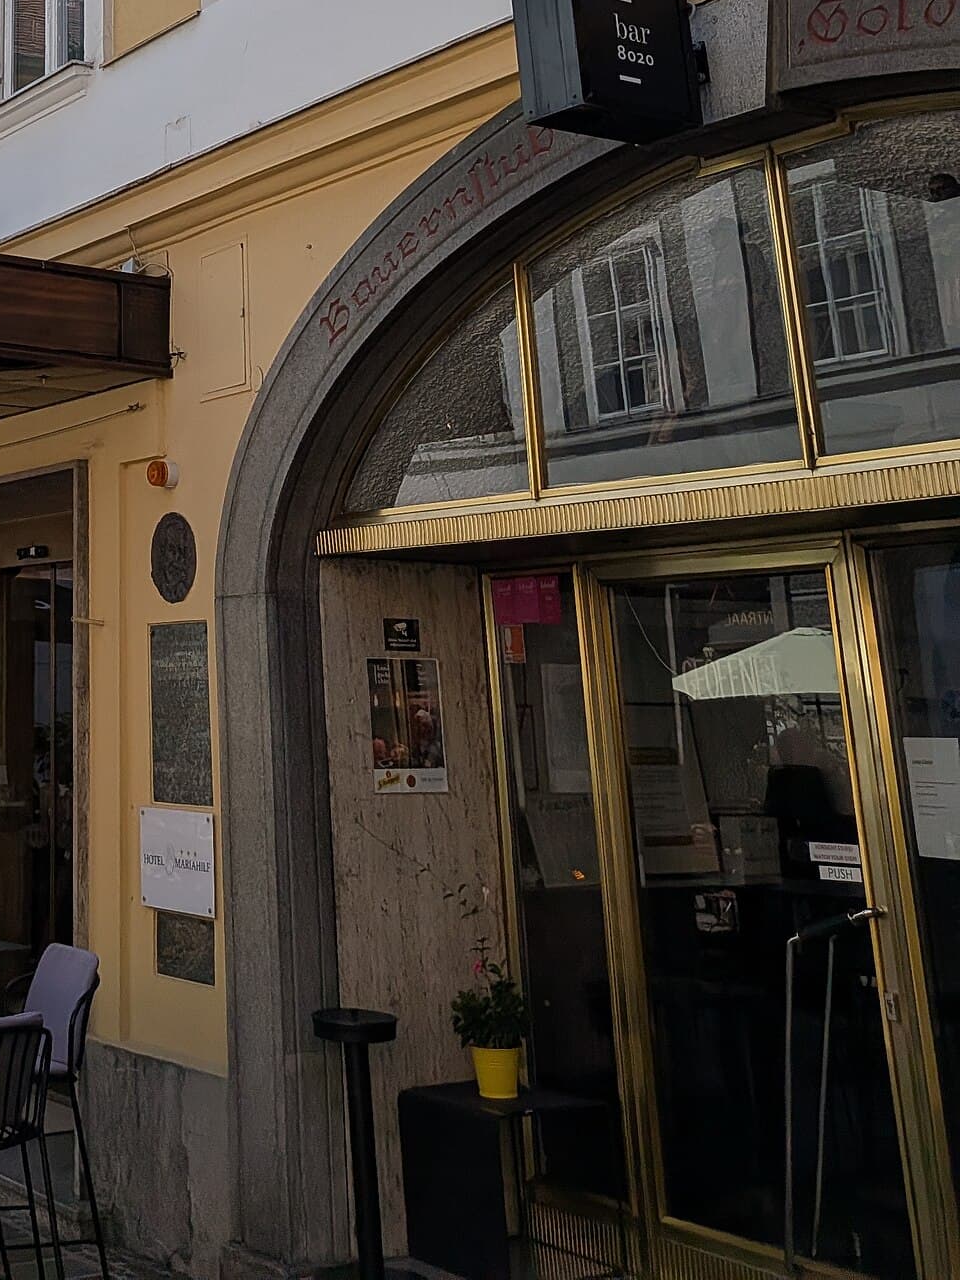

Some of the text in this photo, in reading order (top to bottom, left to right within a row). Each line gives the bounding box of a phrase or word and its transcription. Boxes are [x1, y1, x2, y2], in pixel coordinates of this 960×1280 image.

[613, 12, 650, 44] bar
[617, 44, 654, 66] 8020
[143, 853, 211, 873] HOTEL MARIAHILF
[827, 867, 853, 880] PUSH
